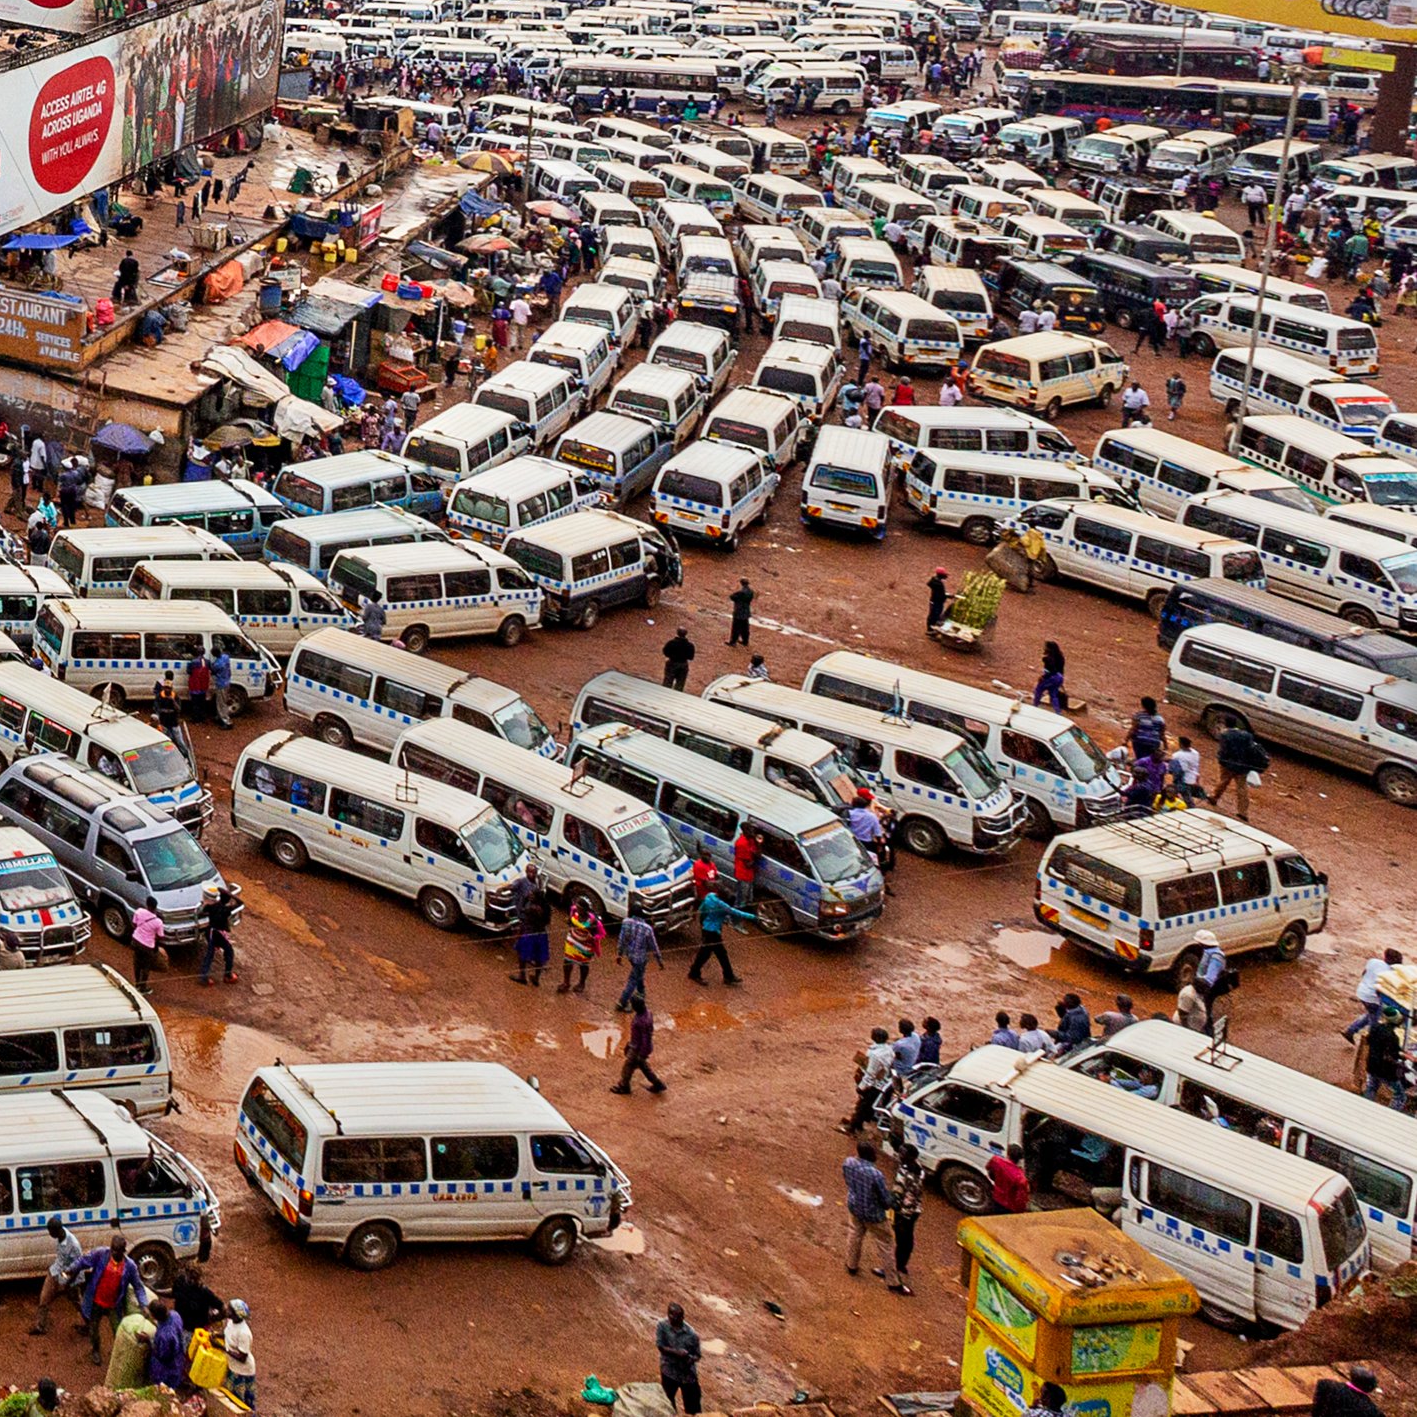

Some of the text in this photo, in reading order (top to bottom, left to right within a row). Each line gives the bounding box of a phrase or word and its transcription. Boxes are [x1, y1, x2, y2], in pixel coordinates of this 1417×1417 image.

[40, 79, 107, 120] ACCESS AIRTEL 4G
[41, 101, 102, 140] ACROSS UGANDA
[41, 148, 58, 166] WITH
[36, 331, 71, 347] SERVICES
[39, 345, 81, 363] AVAILABLE
